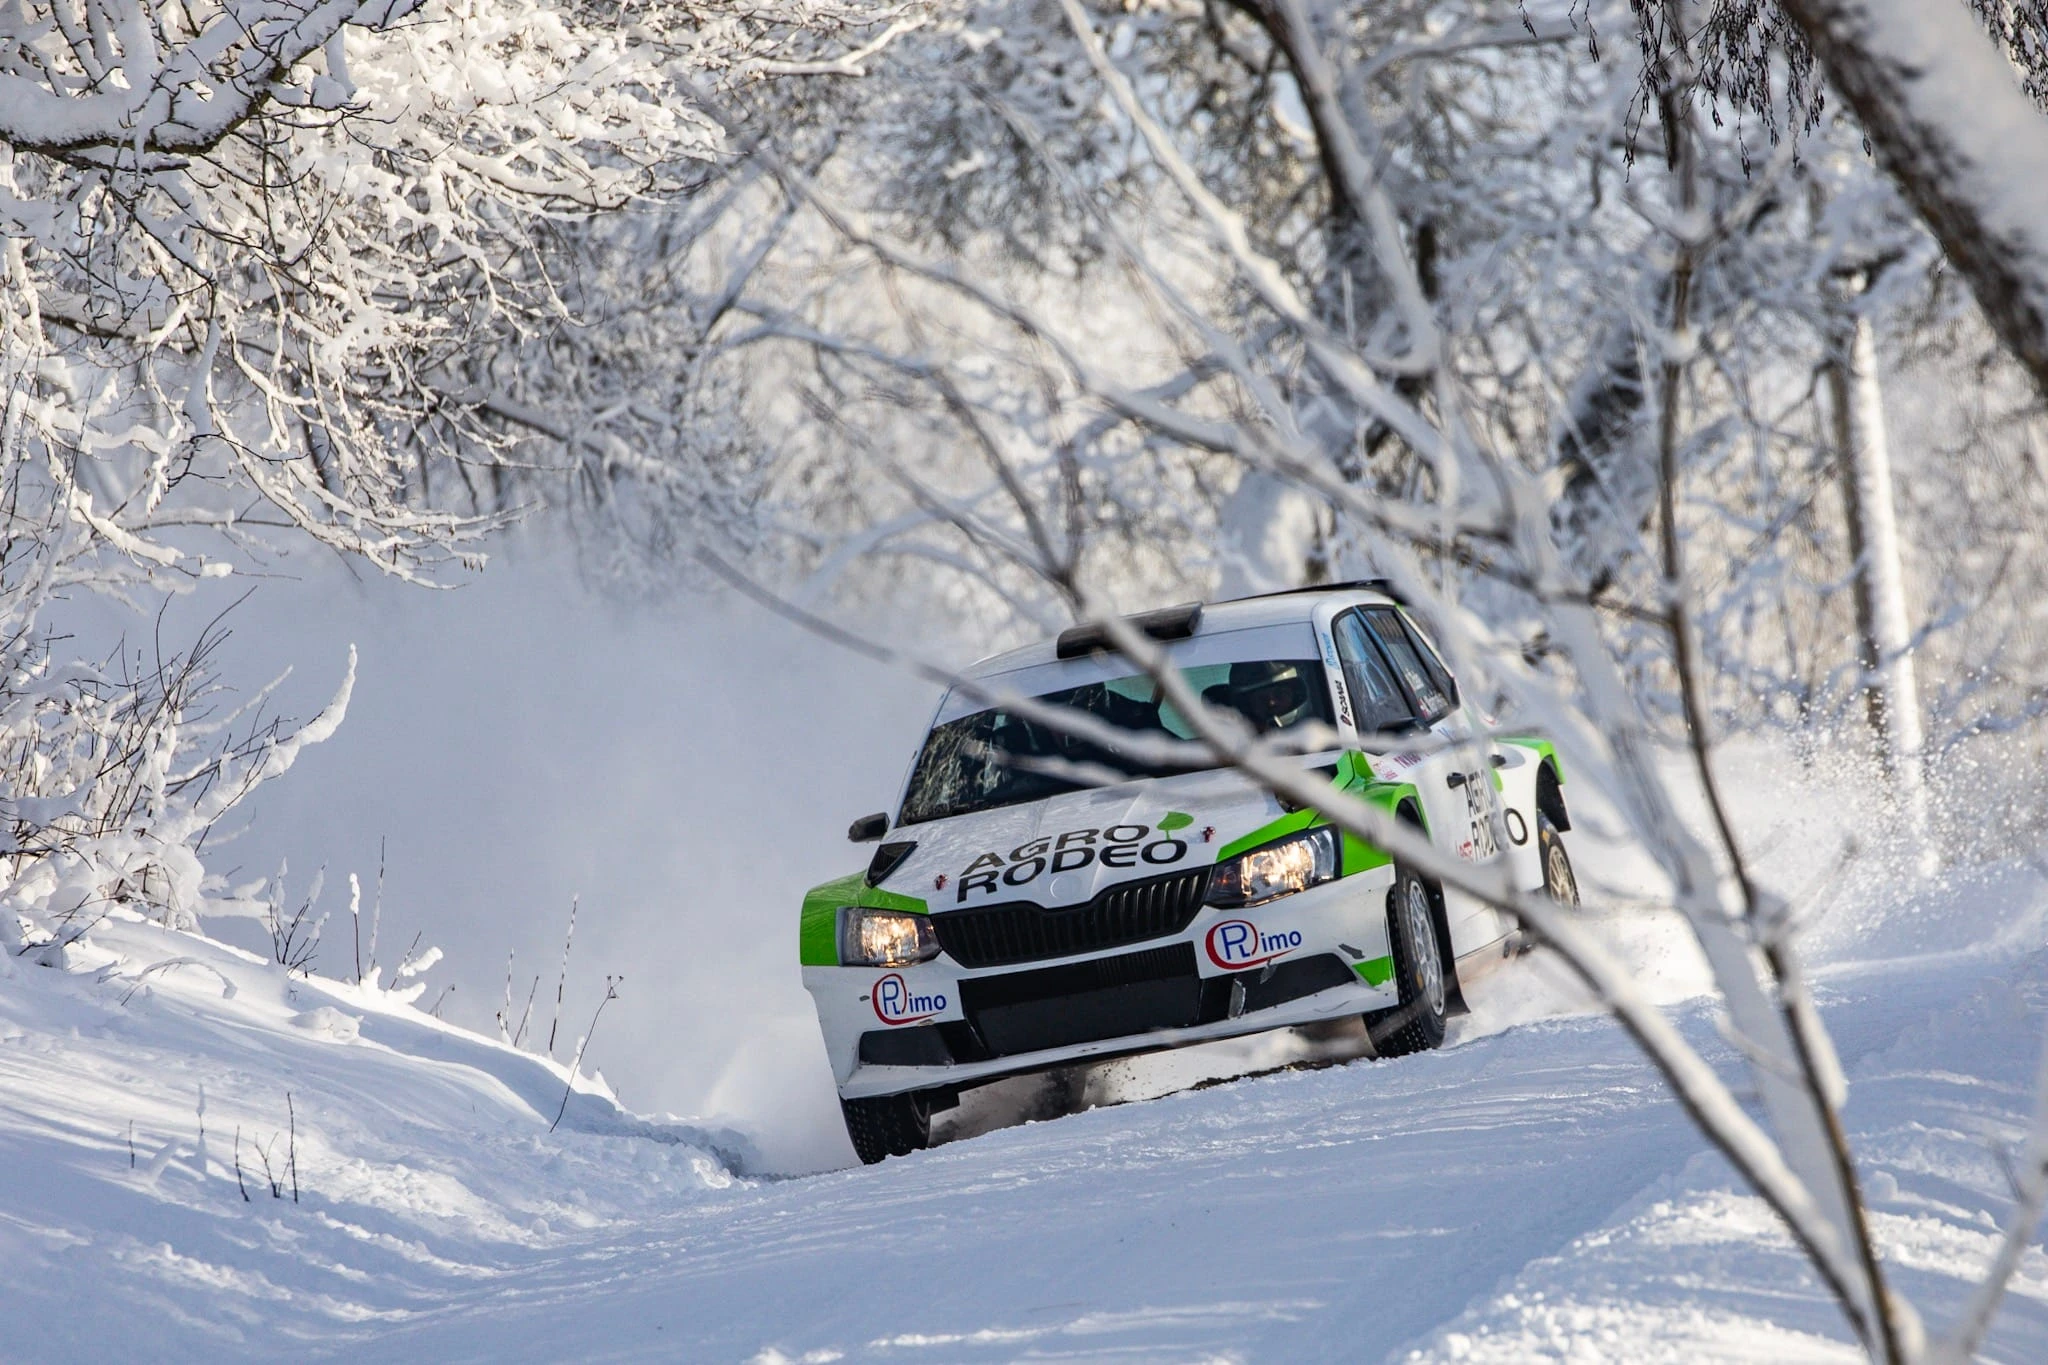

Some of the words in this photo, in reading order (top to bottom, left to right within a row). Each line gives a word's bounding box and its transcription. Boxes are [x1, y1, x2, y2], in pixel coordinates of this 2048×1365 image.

[957, 839, 1188, 903] RODEO
[960, 824, 1150, 877] AGRO
[1220, 924, 1302, 960] Rimo
[882, 981, 947, 1015] Rimo
